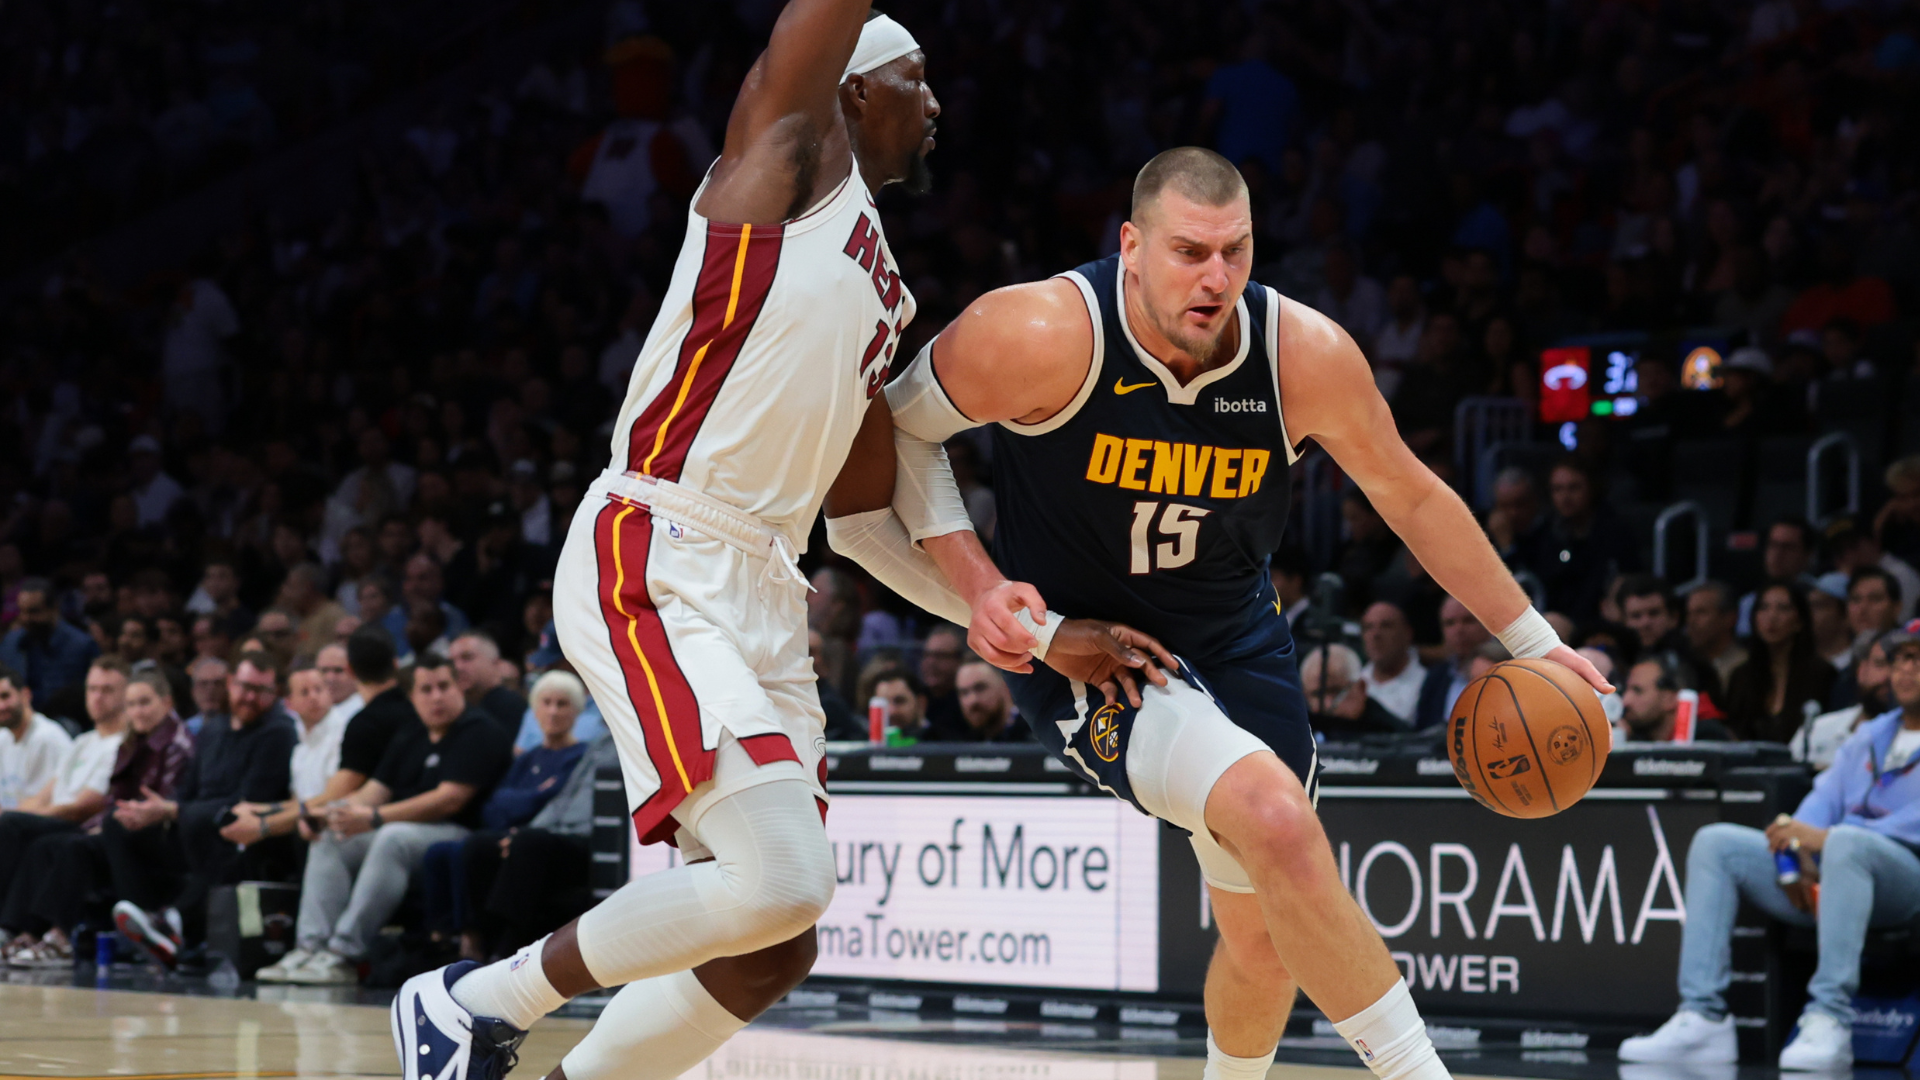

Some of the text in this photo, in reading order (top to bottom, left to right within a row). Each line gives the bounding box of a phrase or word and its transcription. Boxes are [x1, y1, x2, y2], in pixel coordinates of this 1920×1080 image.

[1214, 397, 1267, 413] ibotta
[1085, 432, 1270, 499] DENVER
[1128, 501, 1214, 575] 15
[836, 817, 1109, 906] ury of More
[818, 914, 1052, 966] maTower.com
[1391, 951, 1520, 994] OWER
